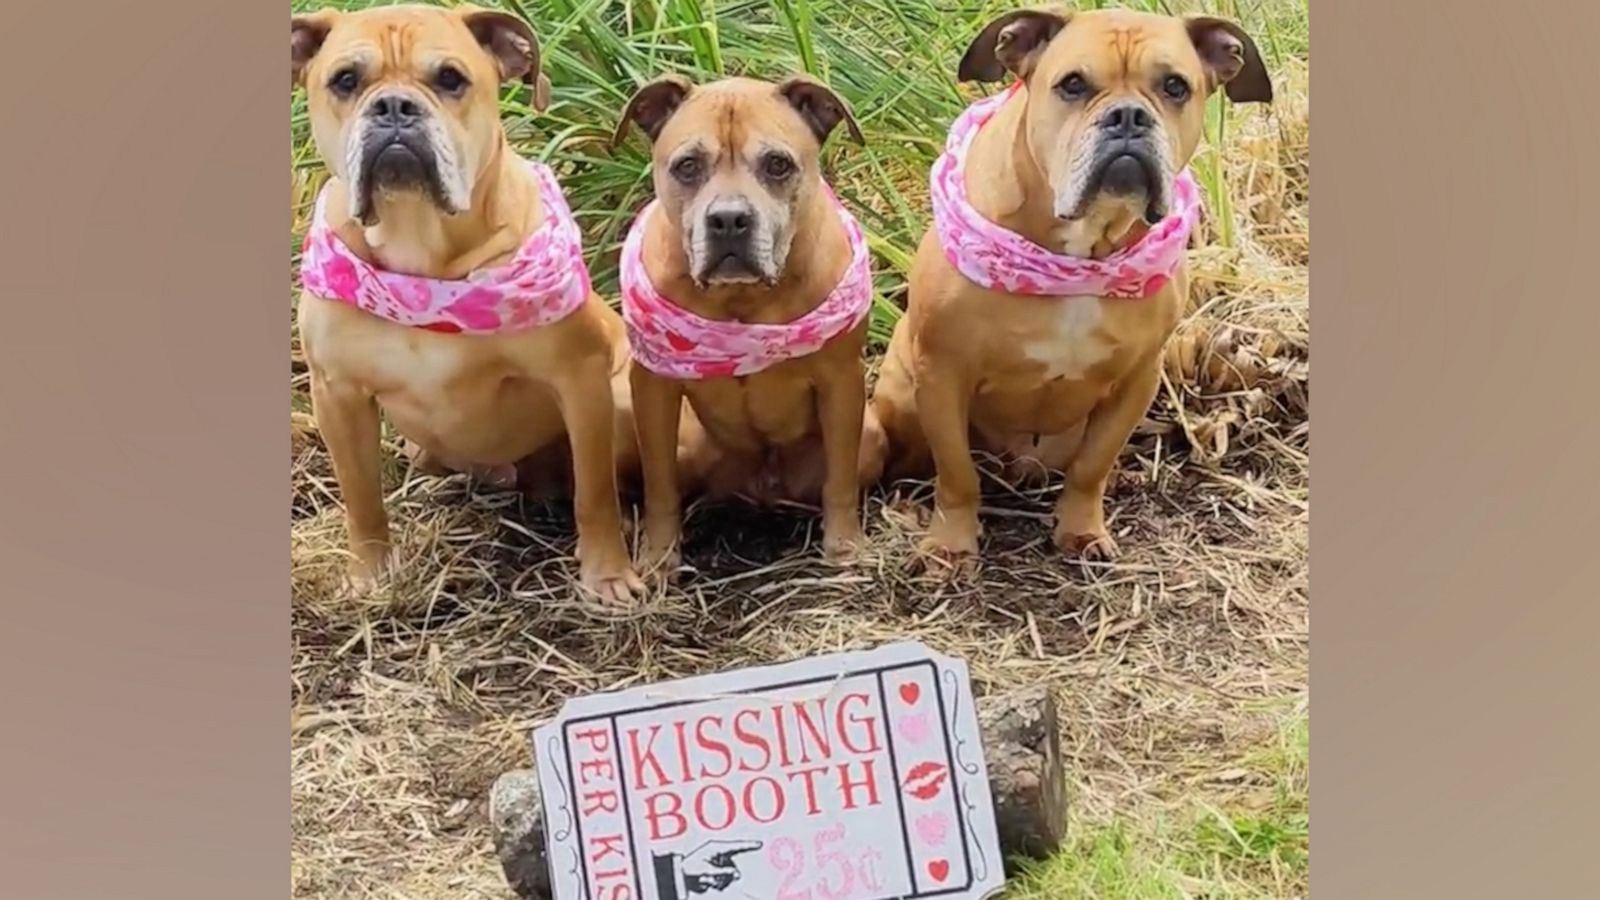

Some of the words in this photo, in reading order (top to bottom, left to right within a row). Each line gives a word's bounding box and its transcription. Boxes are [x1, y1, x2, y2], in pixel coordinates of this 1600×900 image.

[575, 728, 619, 817] PER
[626, 693, 882, 790] KISSING
[644, 759, 882, 841] BOOTH
